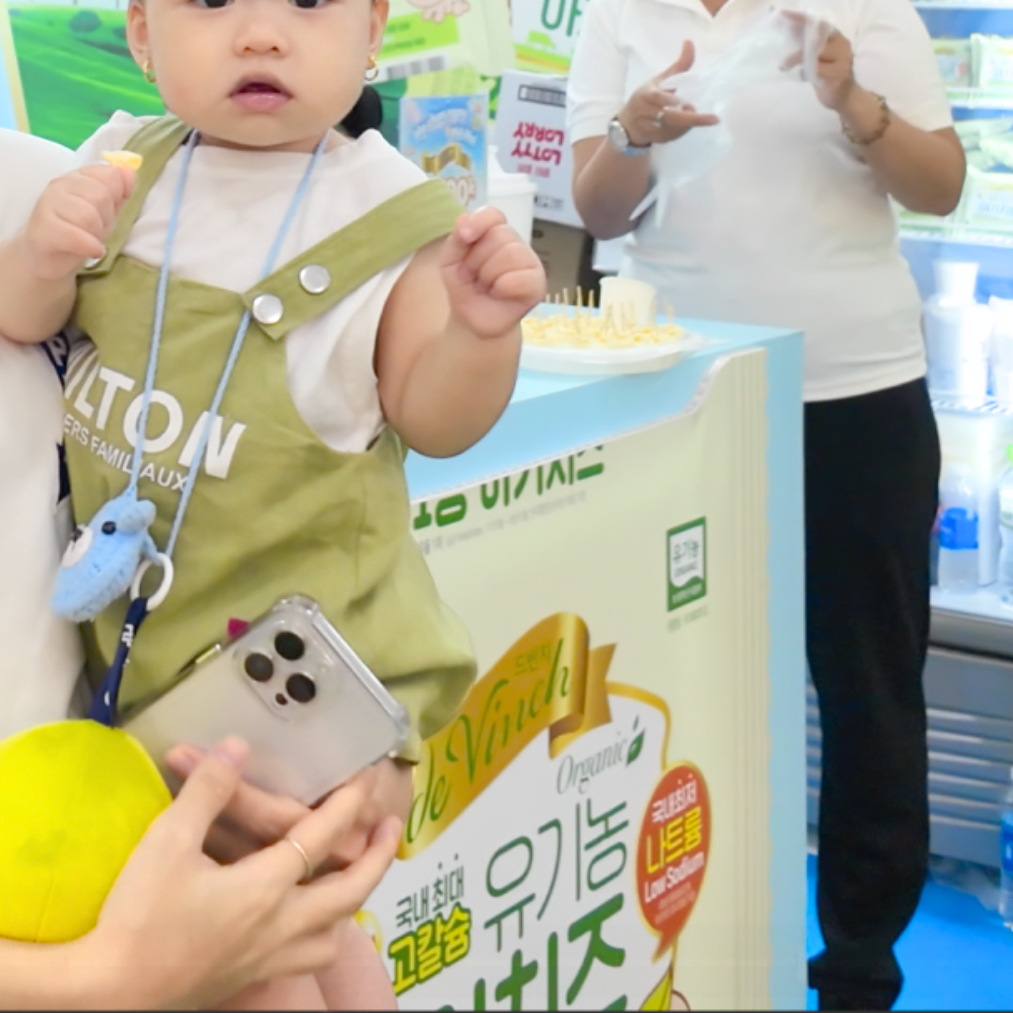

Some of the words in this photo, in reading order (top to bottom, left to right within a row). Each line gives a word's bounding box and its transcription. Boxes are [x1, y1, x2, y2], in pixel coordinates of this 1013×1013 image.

[510, 141, 563, 166] LOTTY
[512, 121, 566, 147] LORRY
[90, 435, 190, 493] FAMILAUX
[445, 638, 570, 785] Vinch
[556, 730, 629, 795] Organic
[645, 805, 702, 874] 나트륨
[395, 884, 430, 929] 국내
[431, 852, 465, 914] 최대
[484, 797, 630, 954] 유기농
[644, 874, 666, 904] Low
[666, 850, 706, 889] Sodium
[388, 900, 473, 997] 고칼슘
